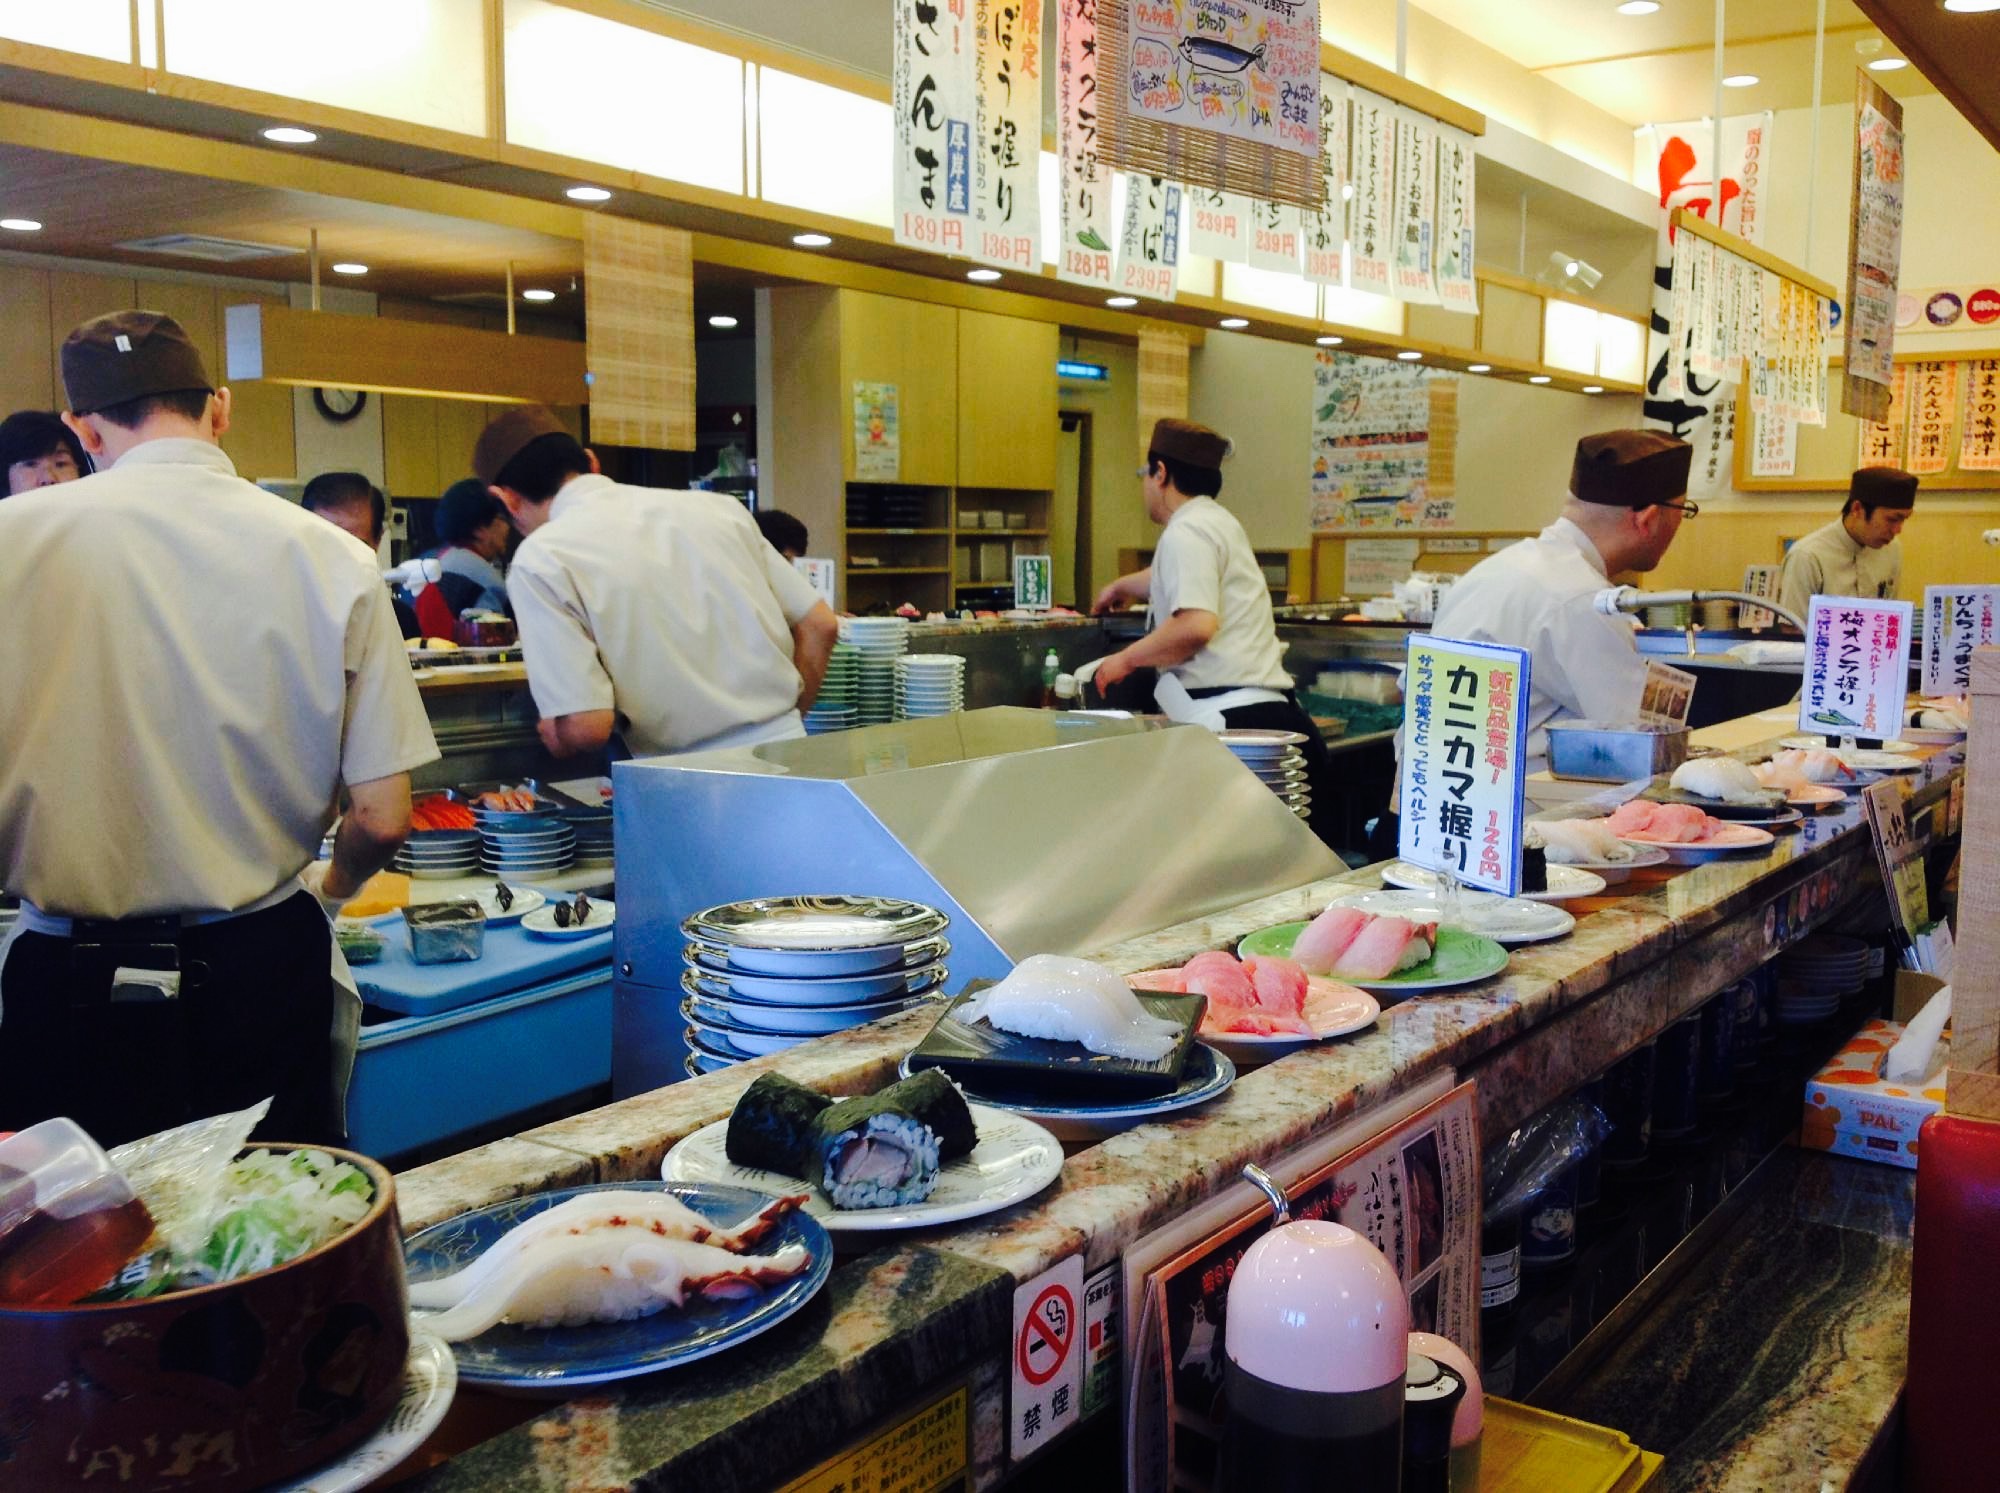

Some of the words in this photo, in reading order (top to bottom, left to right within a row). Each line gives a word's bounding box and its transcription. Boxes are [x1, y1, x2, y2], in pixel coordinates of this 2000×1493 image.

[903, 212, 962, 250] 189円
[982, 232, 1033, 268] 136円
[1439, 664, 1479, 872] カニカマ握り
[1023, 1384, 1070, 1441] 禁煙
